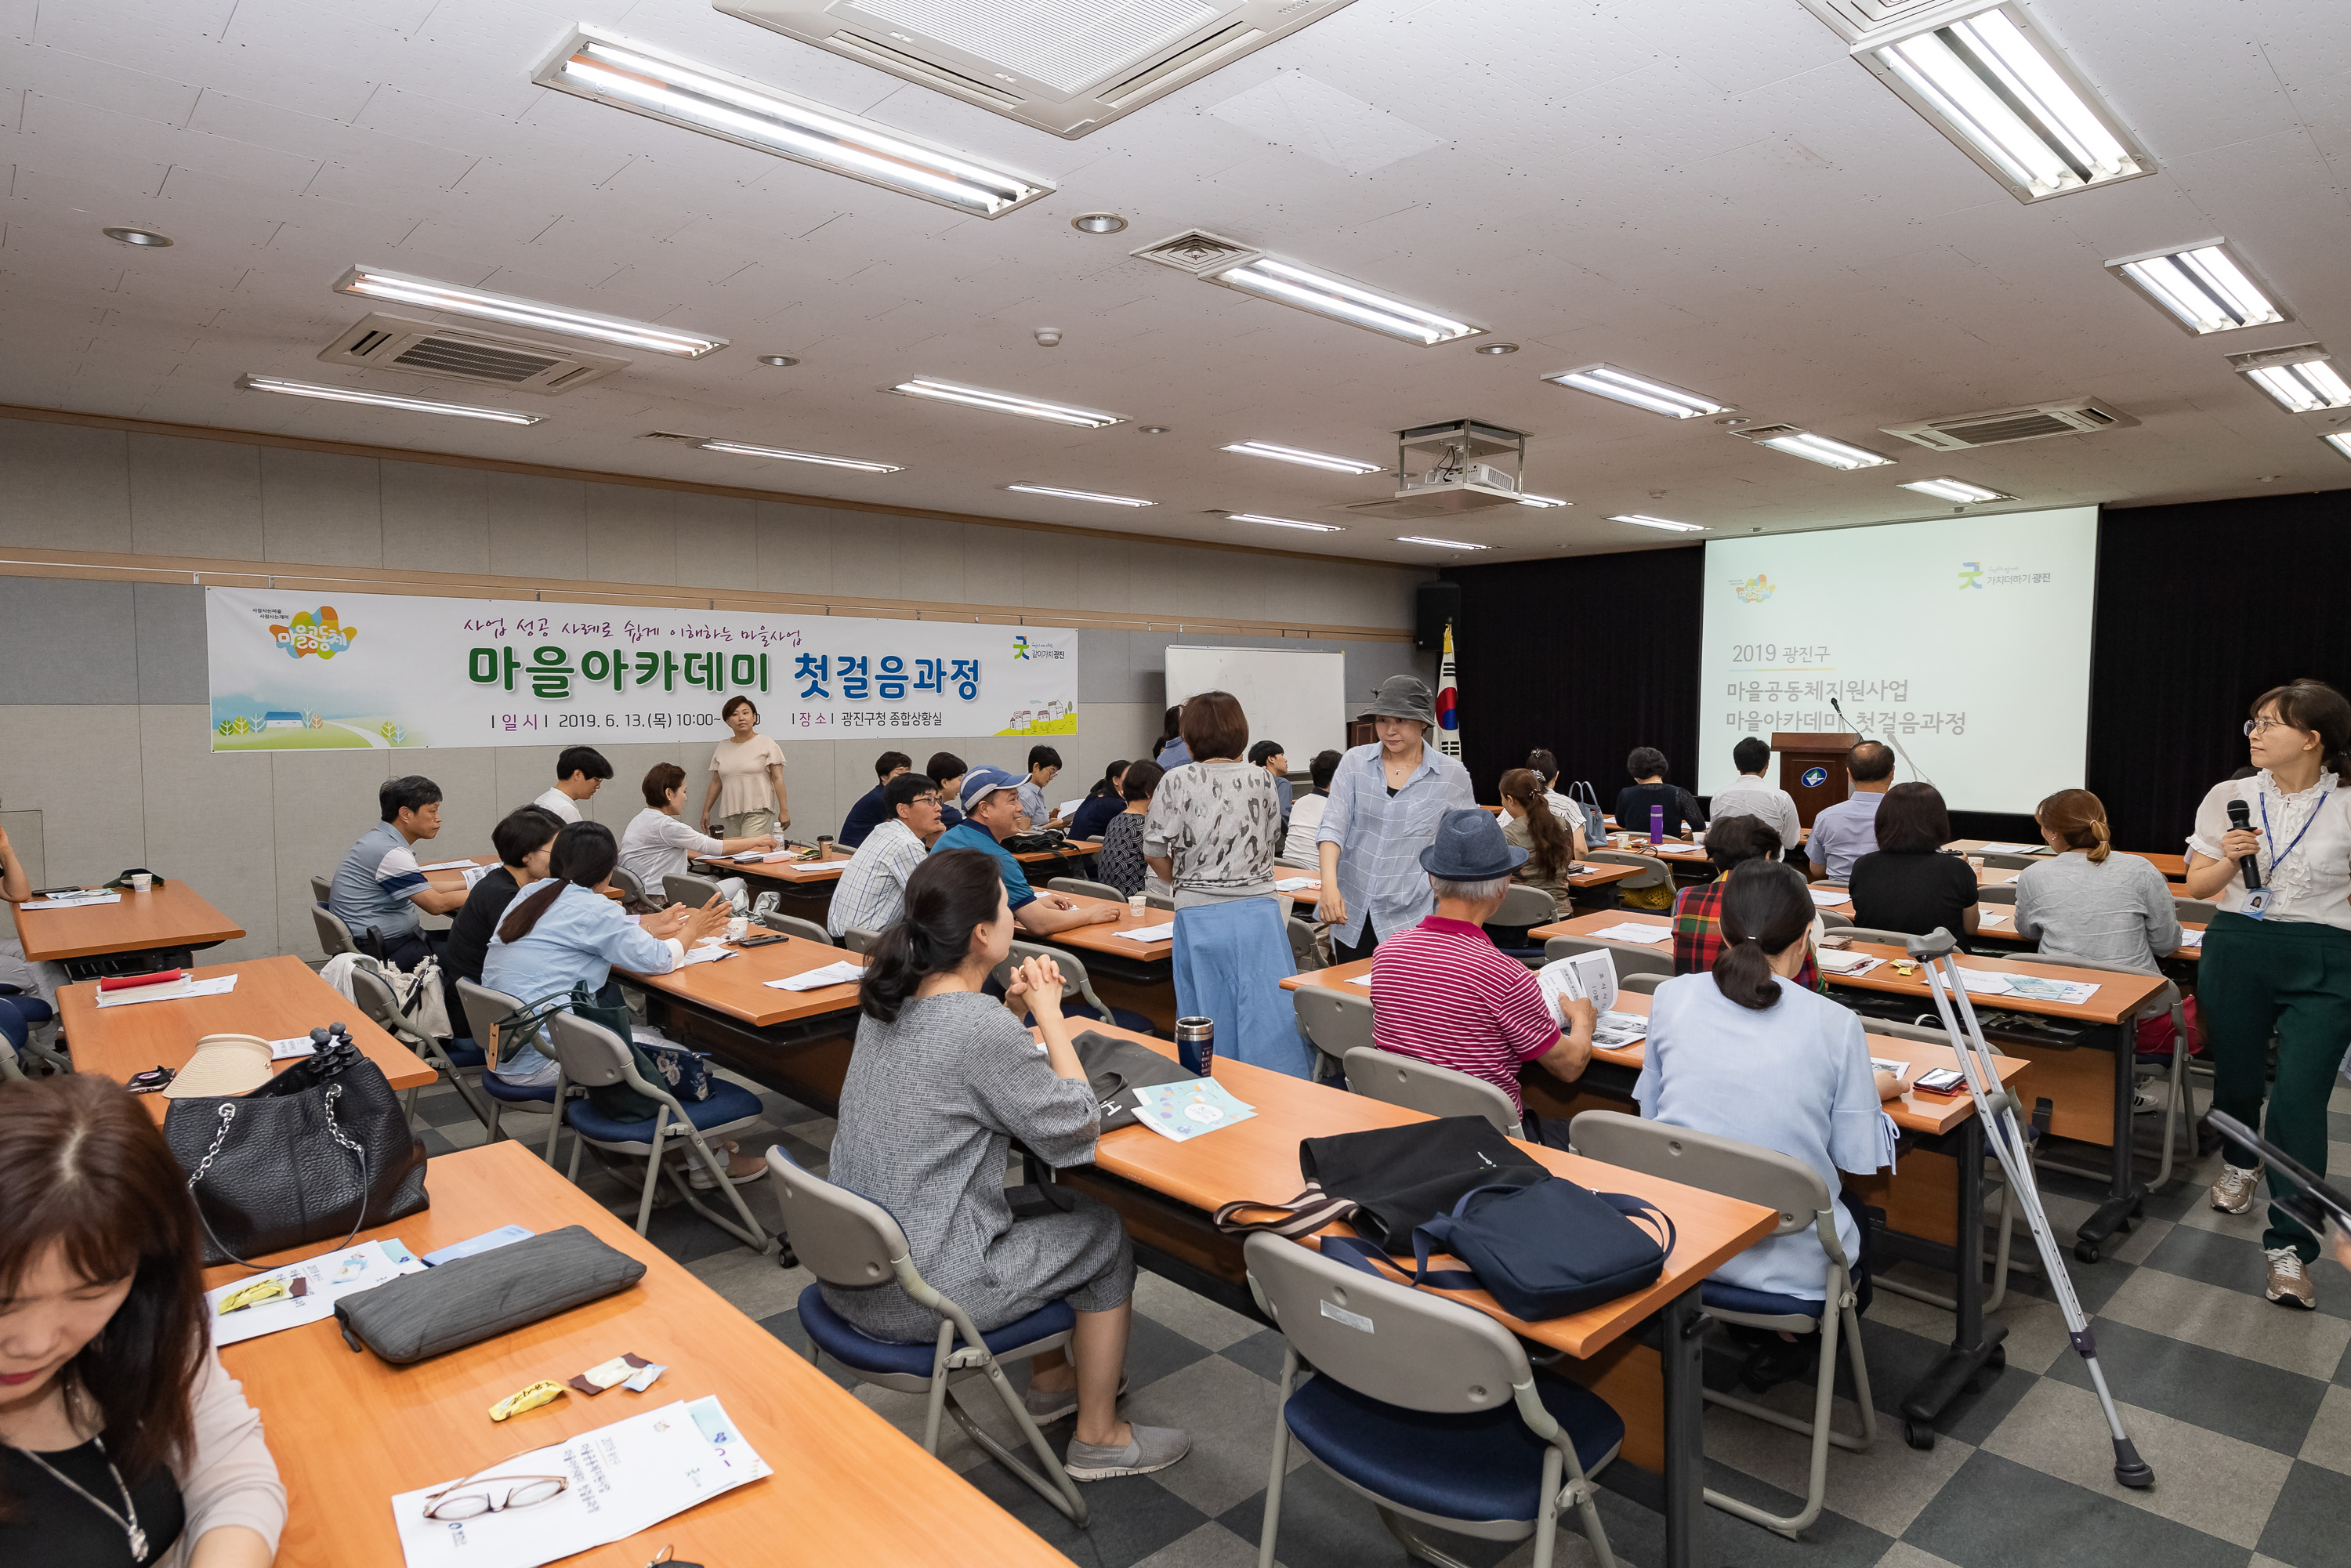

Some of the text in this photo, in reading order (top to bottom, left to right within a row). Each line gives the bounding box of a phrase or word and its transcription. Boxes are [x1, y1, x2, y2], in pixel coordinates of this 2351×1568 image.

[2031, 573, 2051, 584] 광진
[463, 617, 802, 647] 사업 성공 사례로 쉽게 이해하는 마을사업
[1732, 643, 1831, 664] 2019 광진구
[469, 645, 980, 701] 마을아카데미 첫걸음과정
[1726, 679, 1908, 702] 마을공동체지원사업
[559, 713, 600, 728] 2019.
[605, 713, 619, 728] 6.
[841, 712, 886, 727] 광진구청
[889, 712, 942, 726] 종합상황실
[1726, 710, 1965, 736] 마을아카데미 첫걸음과정
